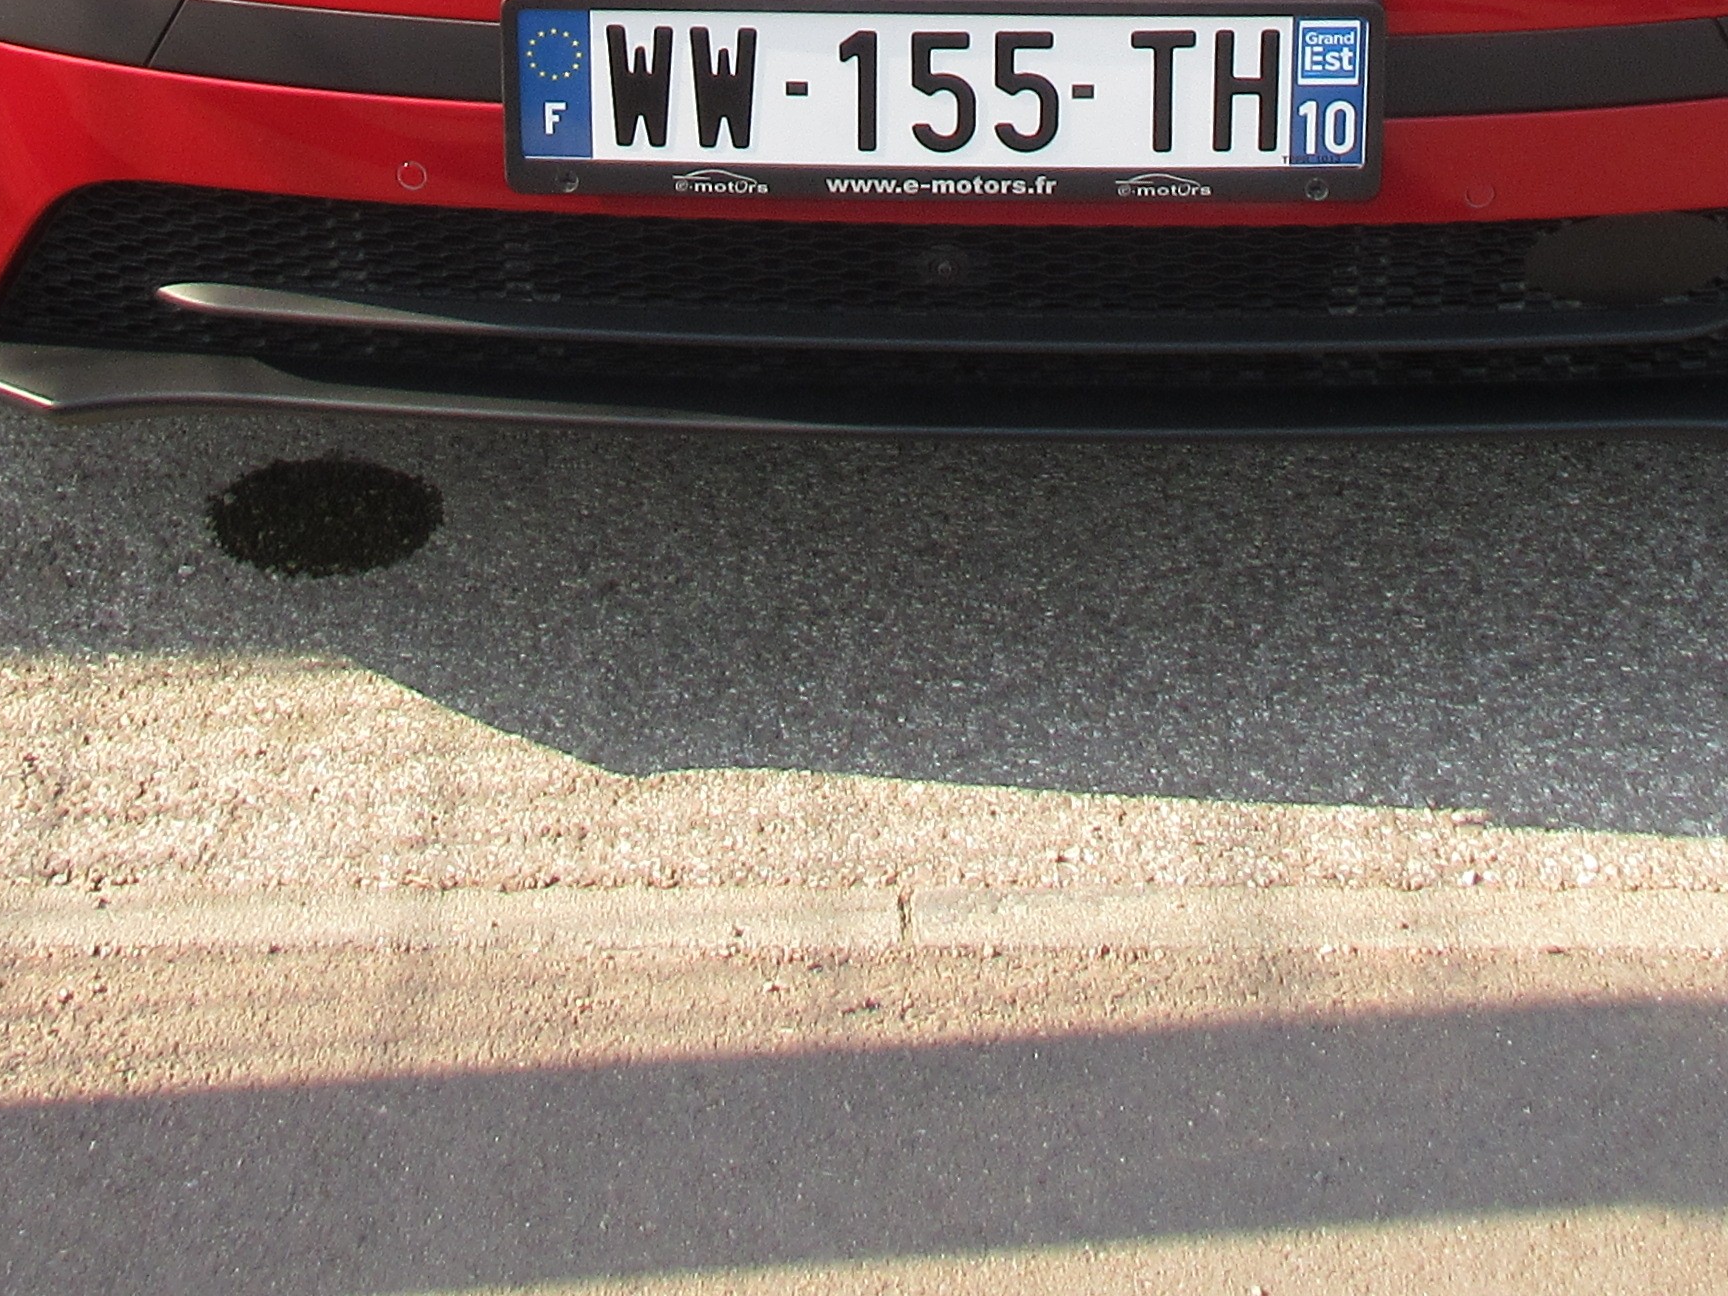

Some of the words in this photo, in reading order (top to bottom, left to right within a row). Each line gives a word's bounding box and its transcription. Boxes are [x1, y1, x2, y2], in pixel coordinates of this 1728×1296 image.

[1305, 32, 1355, 45] Grand
[1304, 46, 1354, 72] Est
[543, 101, 568, 136] F
[1298, 100, 1356, 155] 10
[825, 175, 1057, 196] www.e-motors.fr
